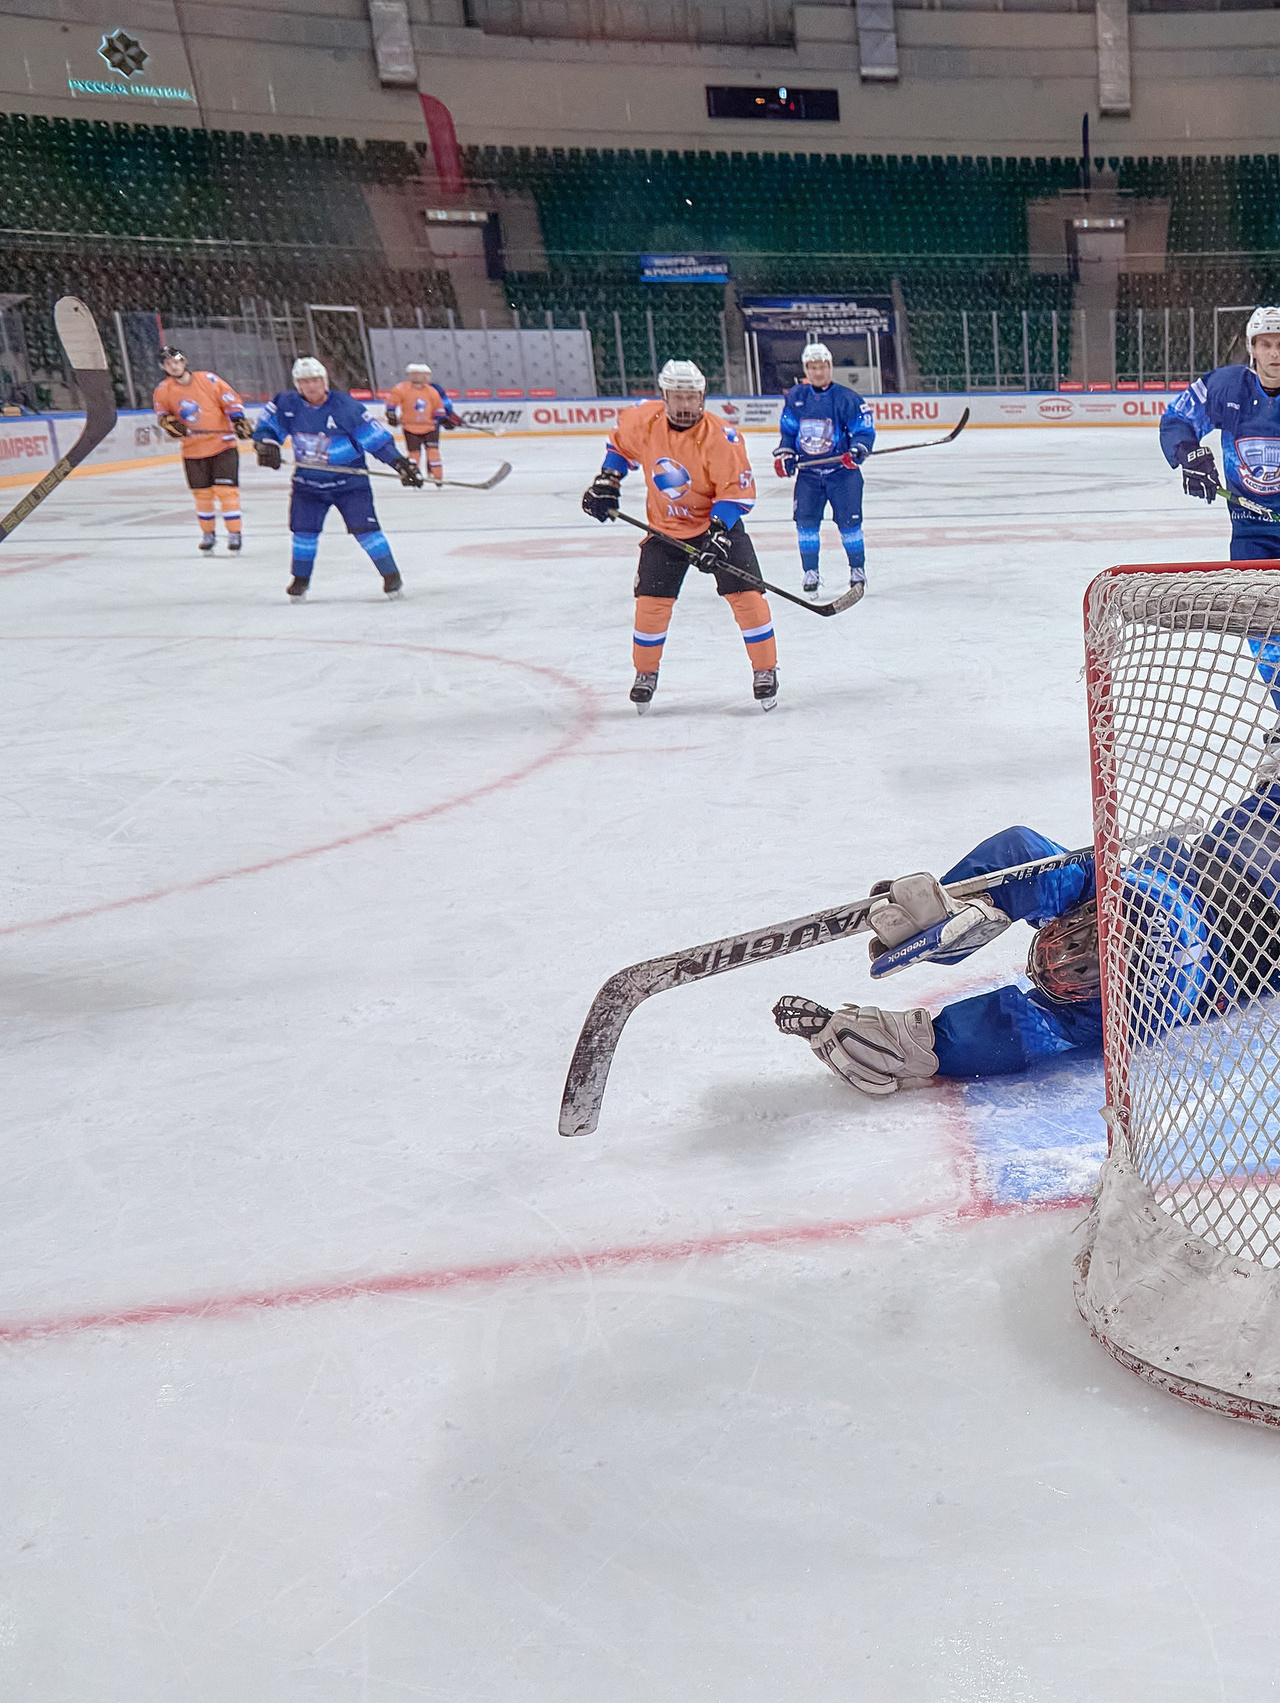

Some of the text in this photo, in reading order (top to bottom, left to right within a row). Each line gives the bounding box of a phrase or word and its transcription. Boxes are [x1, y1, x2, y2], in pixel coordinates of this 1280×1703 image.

[533, 408, 626, 424] OLIMP
[1039, 404, 1072, 413] SINTEC
[887, 937, 927, 963] Reebok
